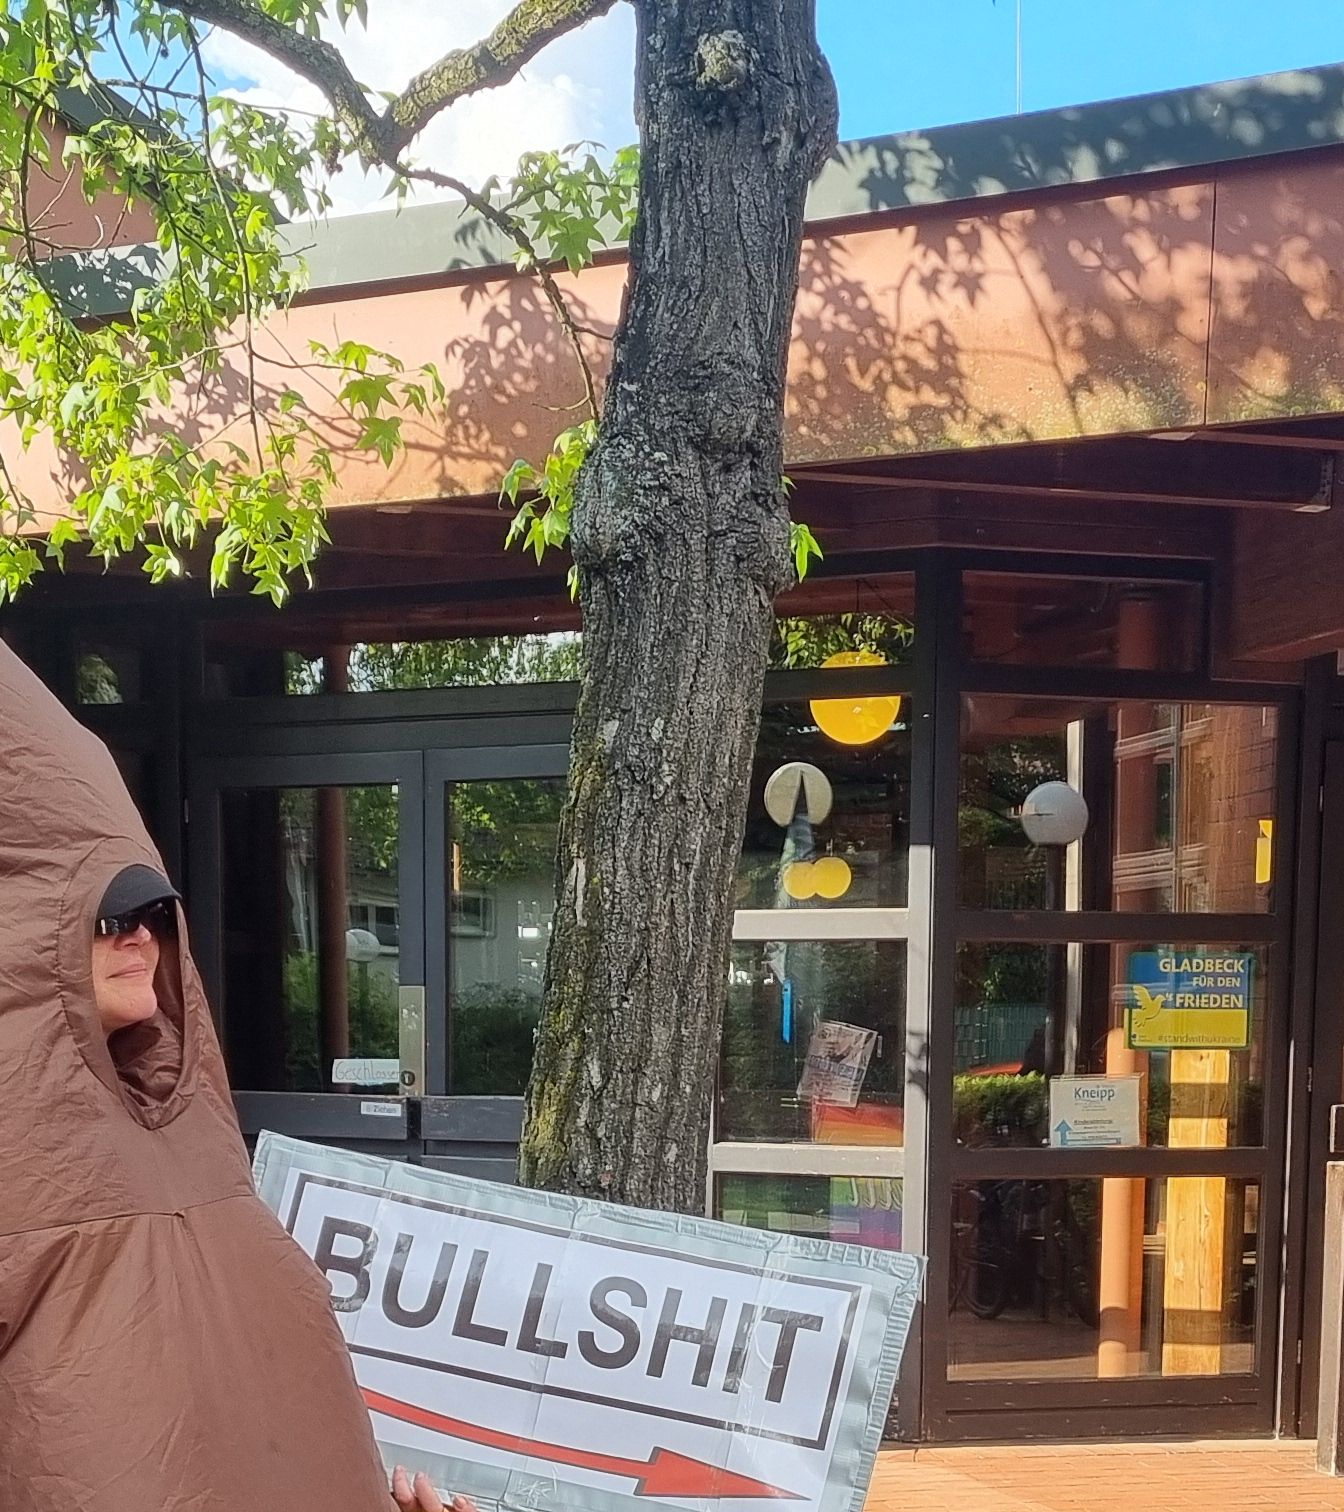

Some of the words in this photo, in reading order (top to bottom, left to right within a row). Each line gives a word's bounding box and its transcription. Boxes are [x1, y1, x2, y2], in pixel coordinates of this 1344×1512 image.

[1159, 958, 1245, 973] GLADBECK
[1192, 975, 1215, 988] FÜR
[1217, 977, 1241, 988] DEN
[1175, 993, 1243, 1008] FRIEDEN
[335, 1061, 398, 1081] Geschlosse
[1074, 1087, 1115, 1101] Kneipp
[313, 1216, 824, 1404] BULLSHIT
